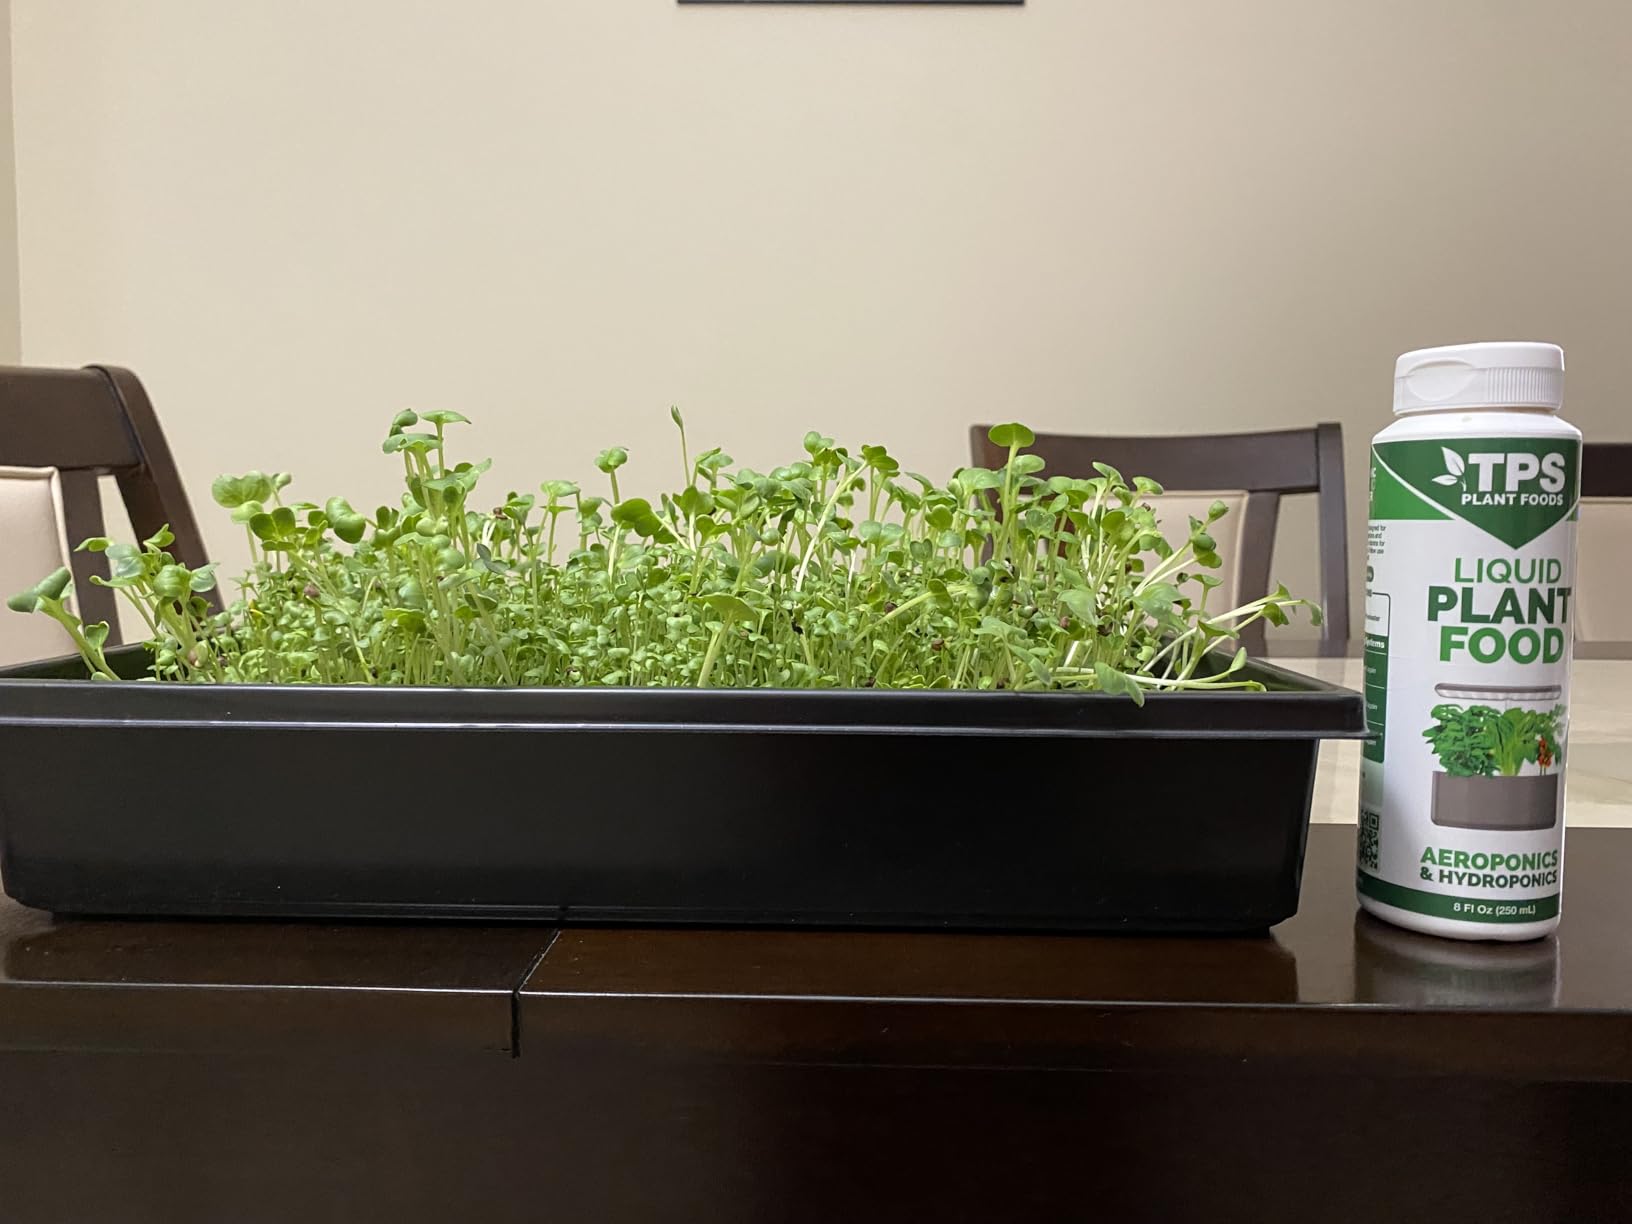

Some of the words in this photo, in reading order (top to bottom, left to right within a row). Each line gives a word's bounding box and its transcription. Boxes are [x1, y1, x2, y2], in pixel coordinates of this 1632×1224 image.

[1468, 452, 1566, 493] TPS
[1461, 493, 1517, 505] PLANT
[1520, 493, 1564, 506] FOODS
[1454, 557, 1562, 584] LIQUID
[1427, 586, 1572, 624] PLANT
[1439, 626, 1564, 665] FOOD
[1420, 846, 1558, 871] AEROPONICS
[1420, 866, 1434, 882] &
[1439, 870, 1557, 888] HYDROPONICS
[1453, 902, 1461, 912] 8
[1477, 905, 1494, 914] Oz
[1495, 906, 1518, 916] (250
[1519, 905, 1536, 915] mL)
